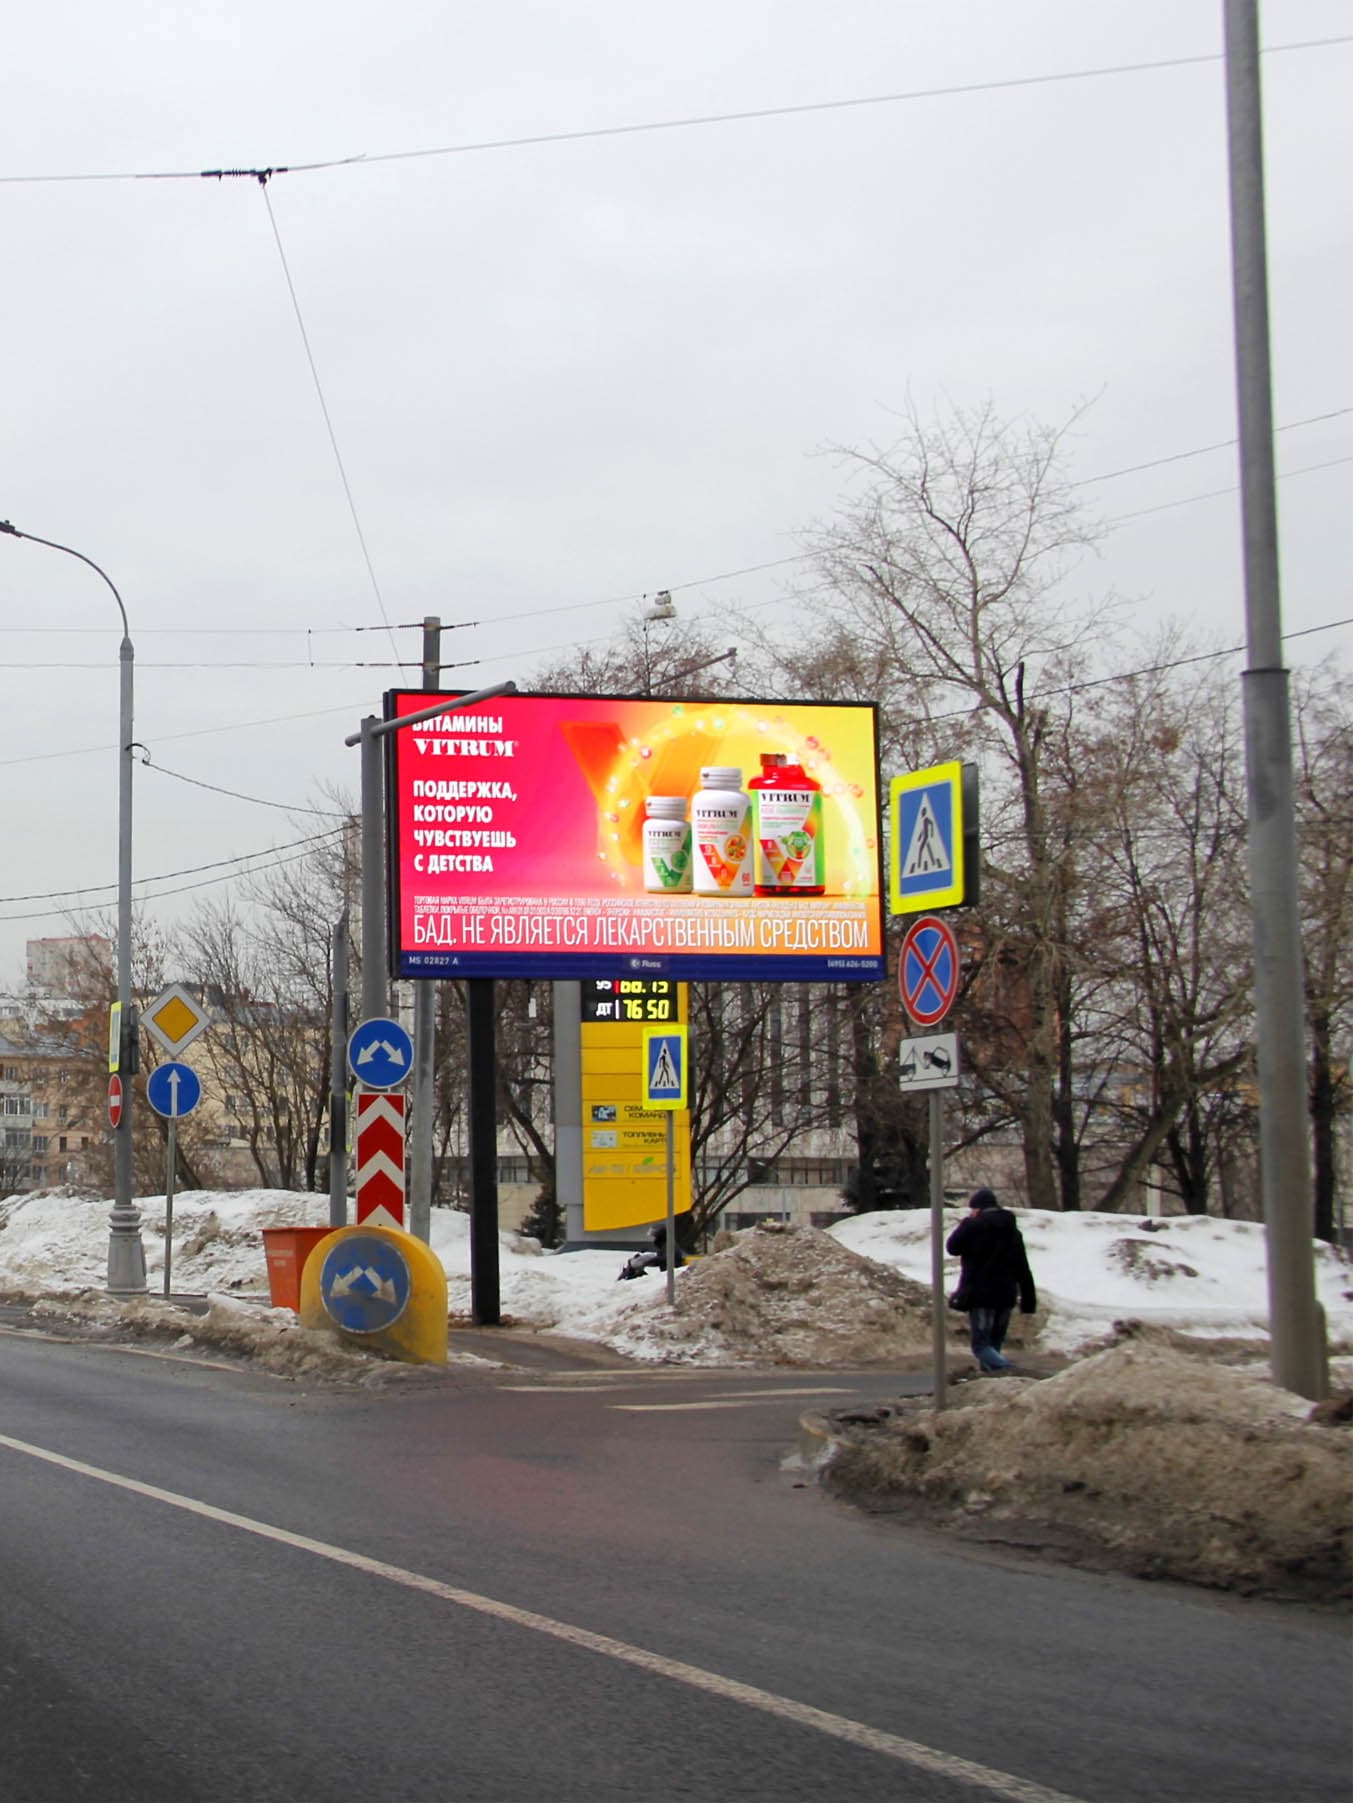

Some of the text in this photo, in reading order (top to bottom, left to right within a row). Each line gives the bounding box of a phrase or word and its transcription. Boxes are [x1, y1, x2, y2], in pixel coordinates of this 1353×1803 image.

[413, 738, 515, 757] VITRUM
[413, 780, 517, 802] ПОДДЕРЖКА,
[761, 793, 810, 802] VITRUM
[413, 804, 493, 823] КОТОРУЮ
[413, 829, 517, 848] ЧУВСТВУЕШЬ
[414, 854, 494, 875] С ДЕТСТВА
[414, 914, 868, 950] БАД. НЕ ЯВЛЯЕТСЯ ЛЕКАРСТВЕННЫМ СРЕДСТВОМ
[596, 1002, 613, 1016] ДТ
